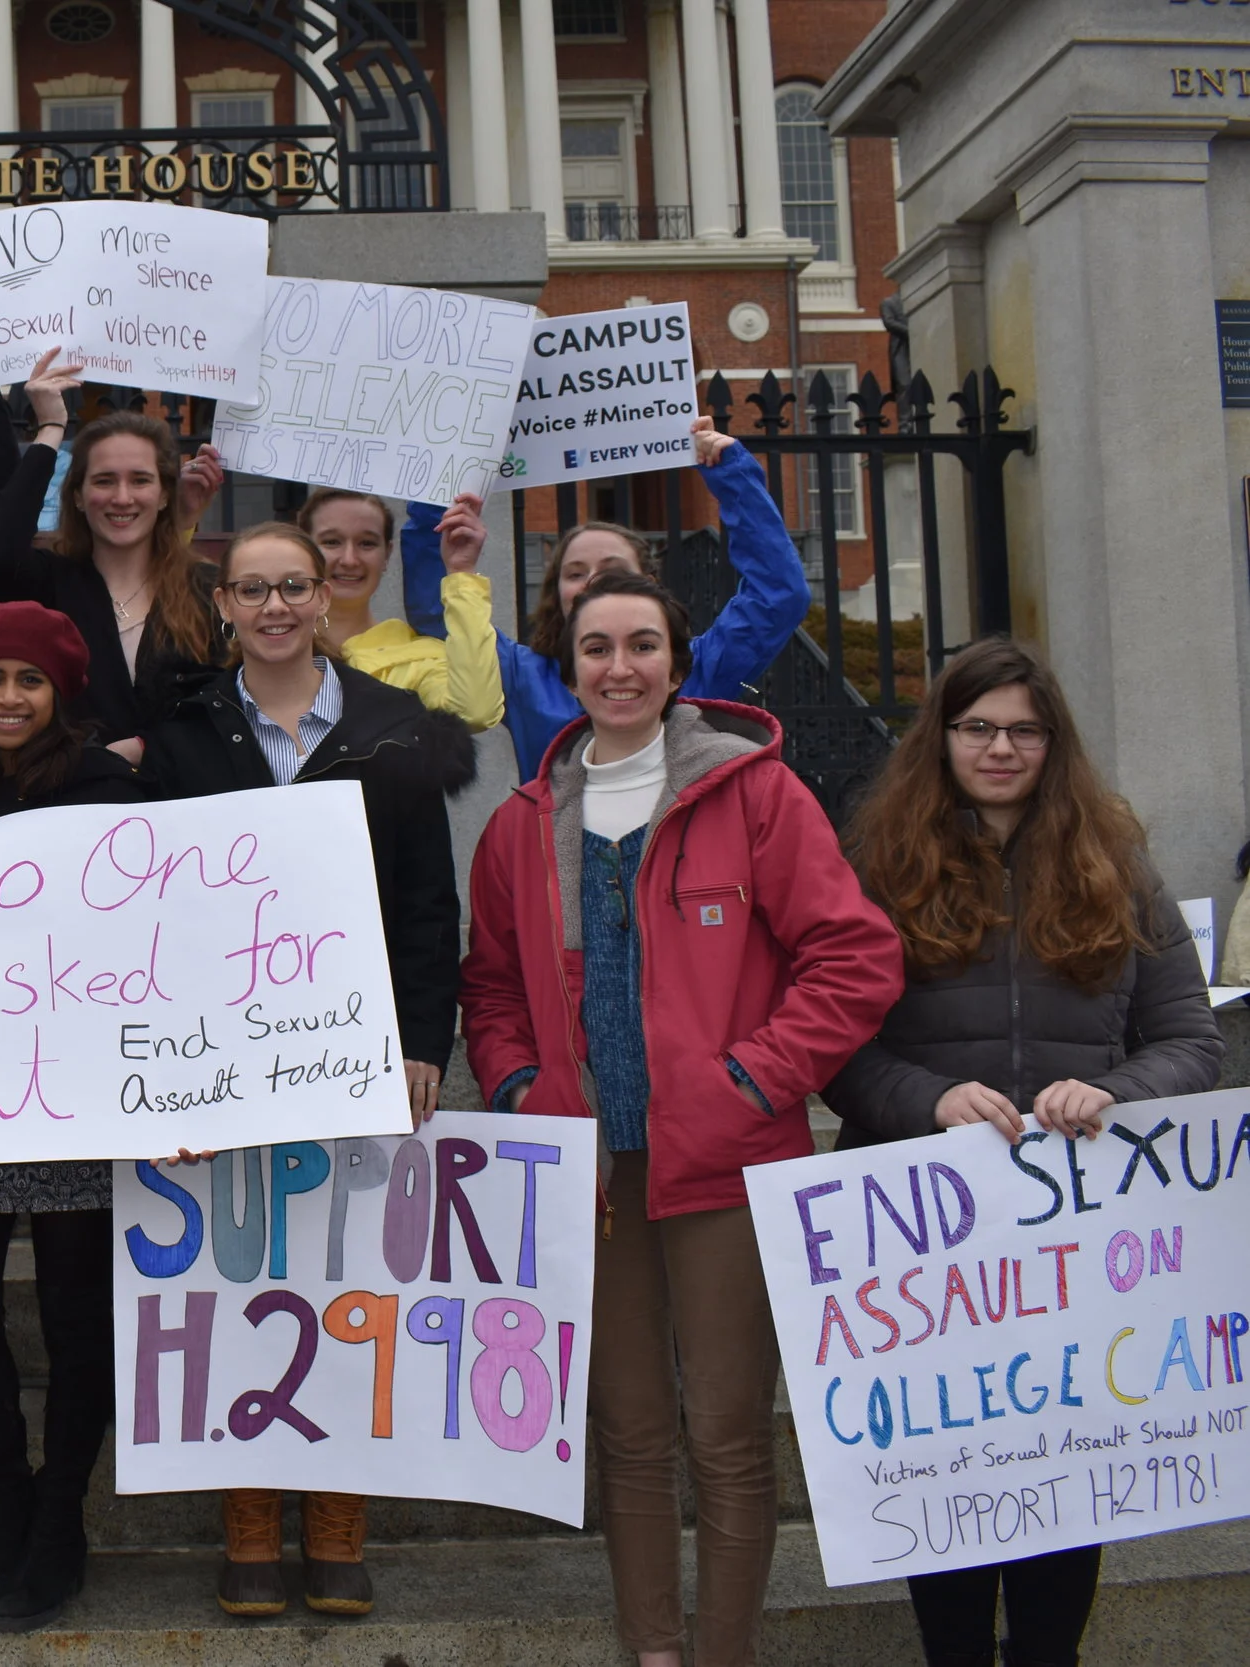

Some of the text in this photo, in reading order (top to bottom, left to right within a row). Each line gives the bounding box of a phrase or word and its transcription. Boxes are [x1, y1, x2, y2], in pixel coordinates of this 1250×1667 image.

[91, 150, 316, 196] HOUSE
[87, 286, 112, 306] on
[105, 315, 207, 350] violence
[330, 283, 529, 373] MORE
[533, 315, 685, 357] CAMPUS
[198, 363, 236, 385] H4159
[226, 354, 510, 448] SILENCE
[558, 358, 689, 397] ASSAULT
[583, 400, 693, 427] #MineToo
[214, 420, 501, 503] IT'S TIME TO ACT
[590, 445, 639, 463] EVERY
[643, 438, 691, 456] VOICE
[82, 817, 270, 911] One
[225, 890, 346, 1006] for
[119, 991, 363, 1060] End Sexual
[265, 1035, 392, 1098] today!
[124, 1137, 561, 1288] SUPPORT
[794, 1162, 976, 1285] END
[815, 1226, 1182, 1365] ASSAULT ON
[133, 1289, 575, 1463] H.2998!
[825, 1312, 1250, 1449] COLLEGE CAMP
[864, 1405, 1249, 1485] Victims of Sexual Assault Should NOT
[872, 1475, 1069, 1563] SUPPORT
